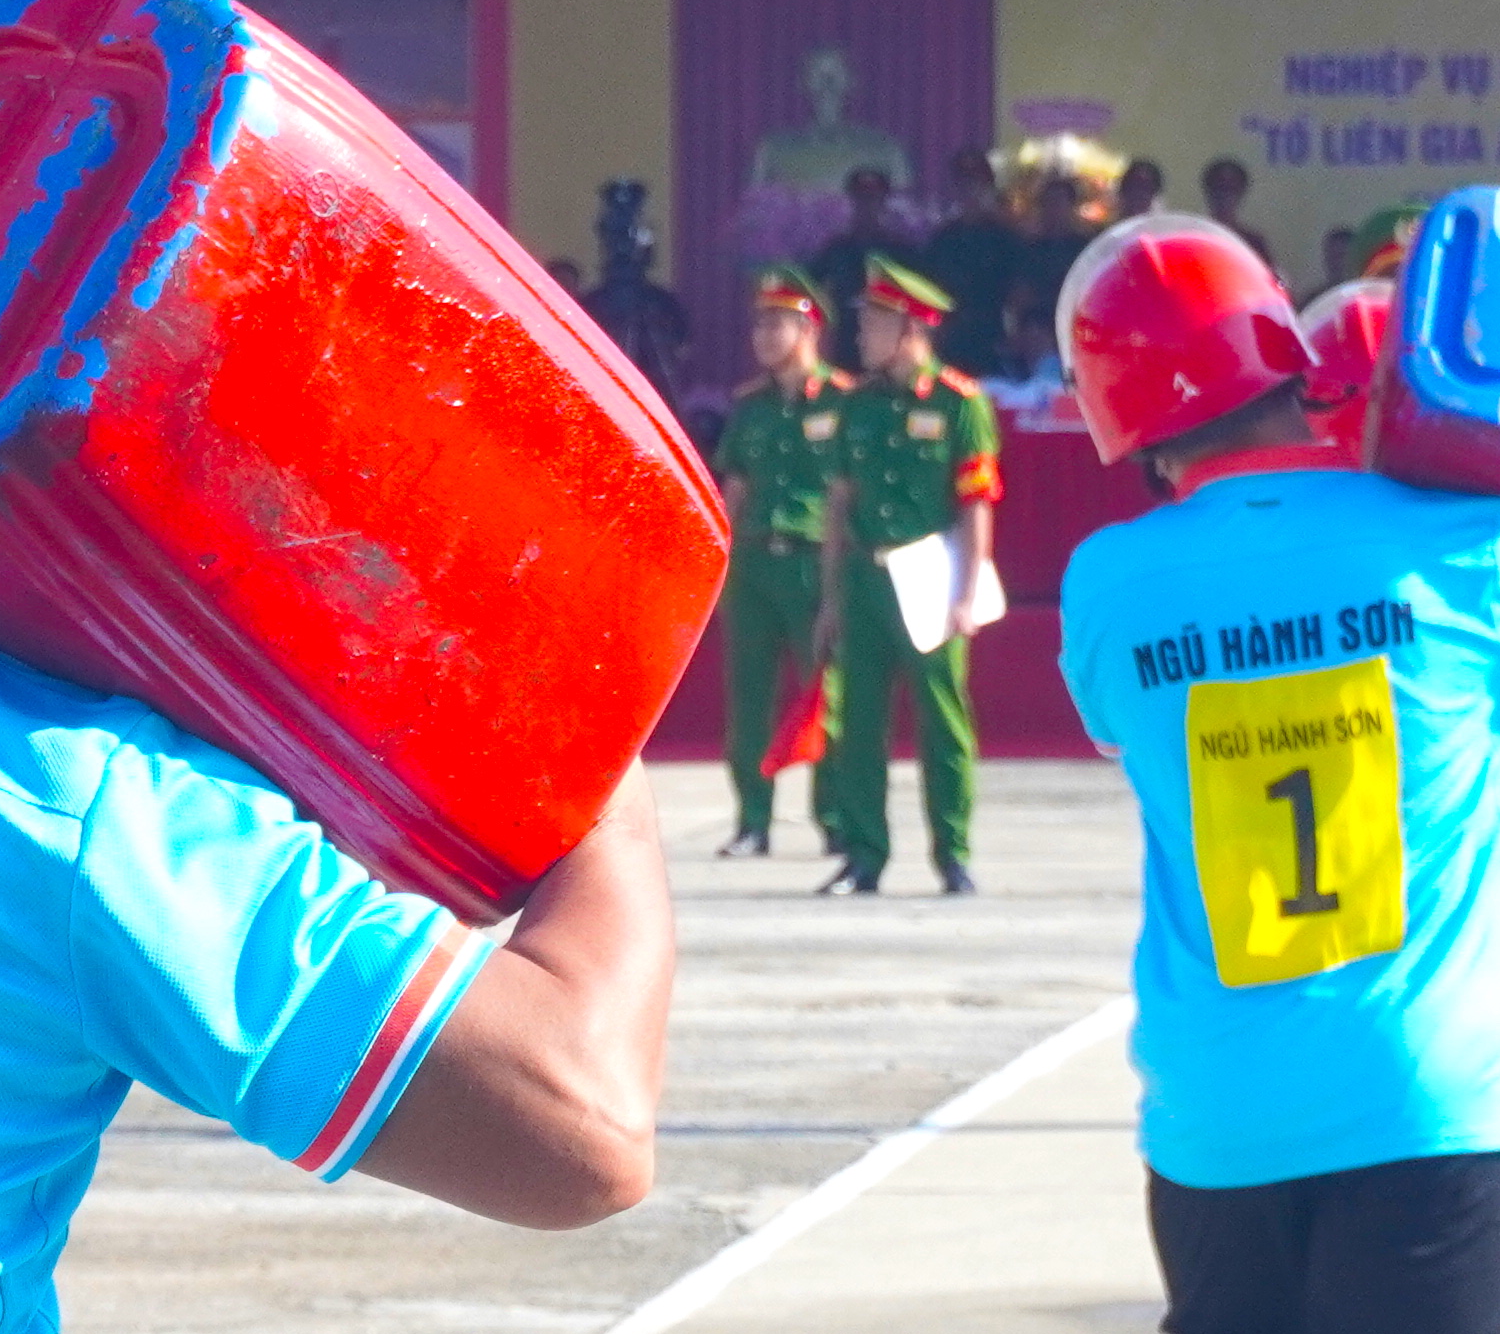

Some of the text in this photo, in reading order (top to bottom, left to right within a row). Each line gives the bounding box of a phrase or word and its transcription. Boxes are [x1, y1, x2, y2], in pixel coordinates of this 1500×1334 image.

[1284, 48, 1427, 105] NGHIỆP
[1441, 53, 1490, 105] VỤ
[1322, 114, 1407, 166] LIÊN
[1421, 121, 1484, 165] GIA
[1132, 599, 1415, 690] NGŨ HÀNH SƠN
[1258, 716, 1327, 754] HÀNH
[1334, 707, 1383, 743] SƠN
[1266, 766, 1340, 918] 1
